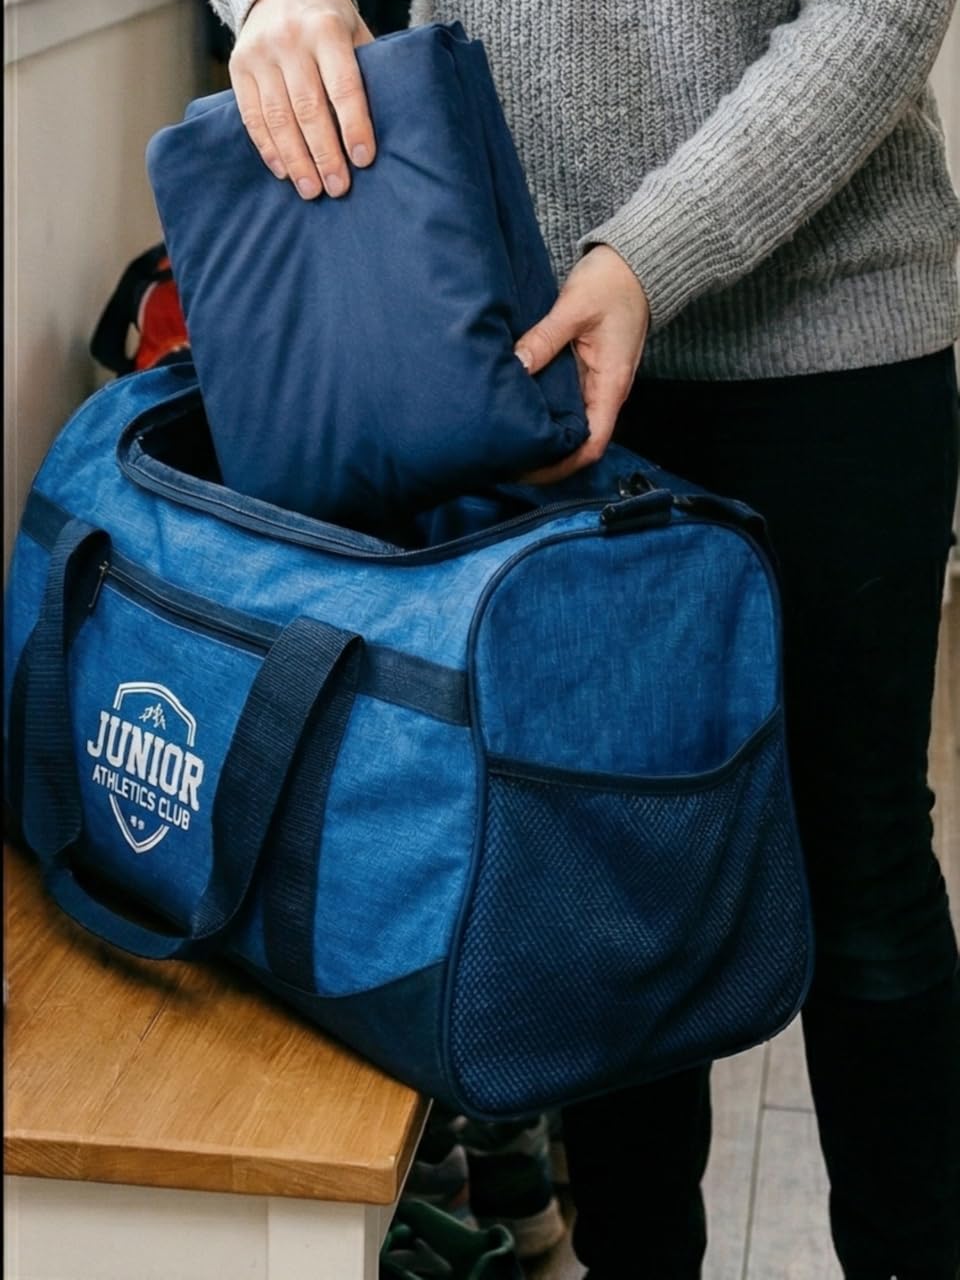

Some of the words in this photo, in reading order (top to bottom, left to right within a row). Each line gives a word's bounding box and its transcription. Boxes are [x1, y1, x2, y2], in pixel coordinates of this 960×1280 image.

[87, 710, 204, 811] JUNIOR
[92, 764, 156, 811] ATHLETICS
[158, 798, 191, 831] CLUB
